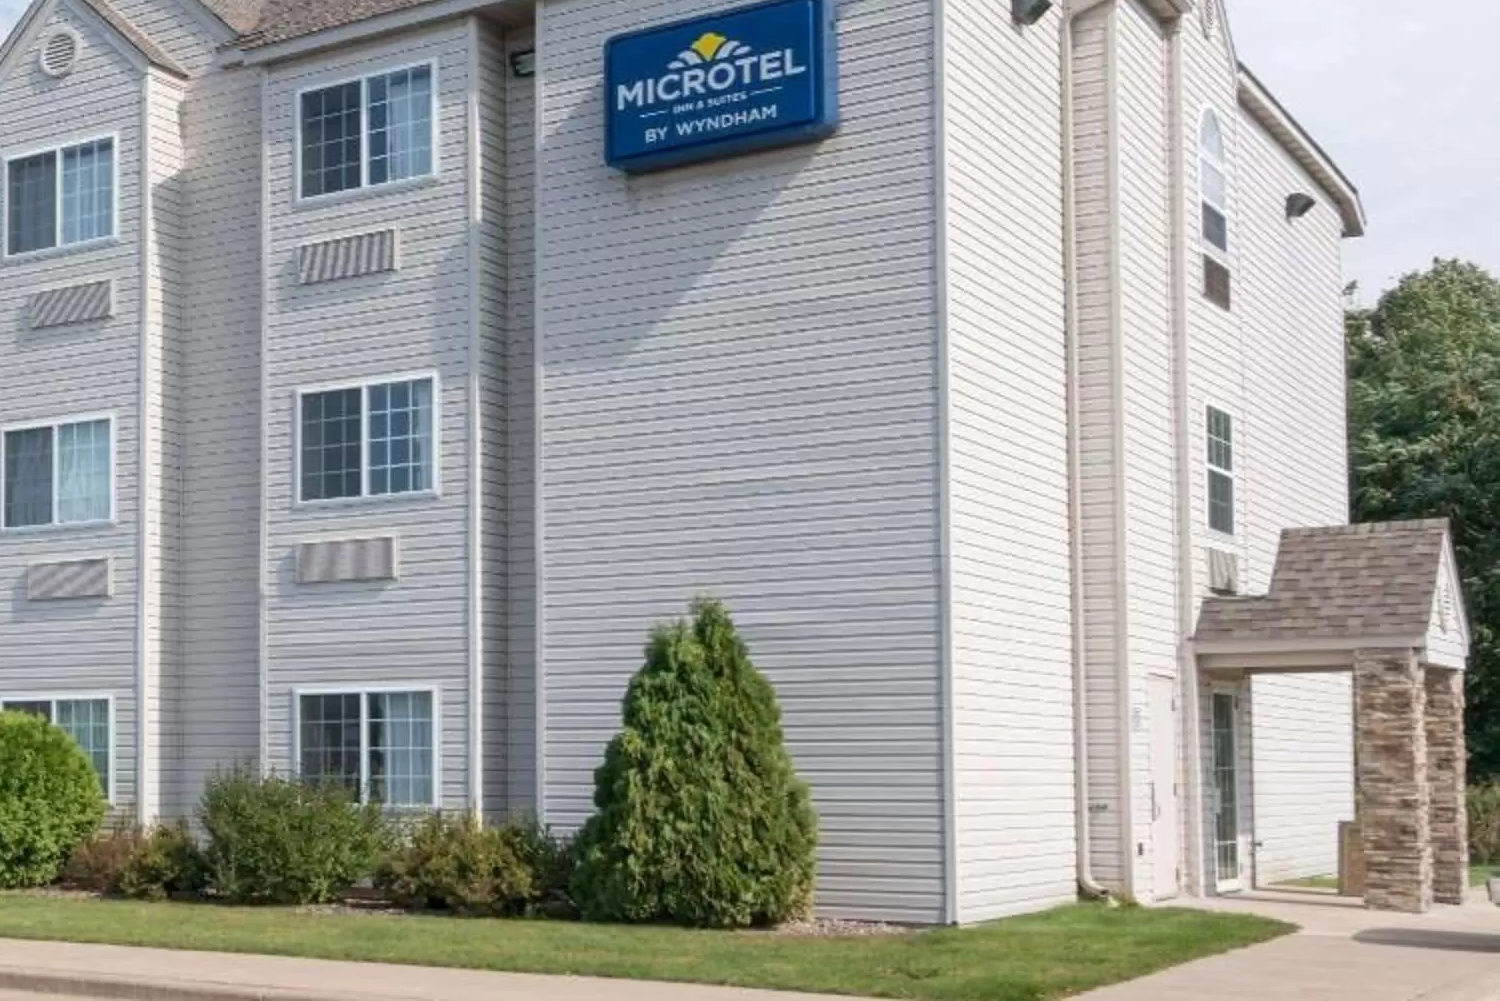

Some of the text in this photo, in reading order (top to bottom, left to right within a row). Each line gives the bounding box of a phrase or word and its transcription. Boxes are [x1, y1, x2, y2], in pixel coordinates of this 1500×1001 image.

[617, 49, 806, 110] MICROTEL
[645, 104, 777, 143] BY WYNDHAM
[673, 102, 694, 114] INN
